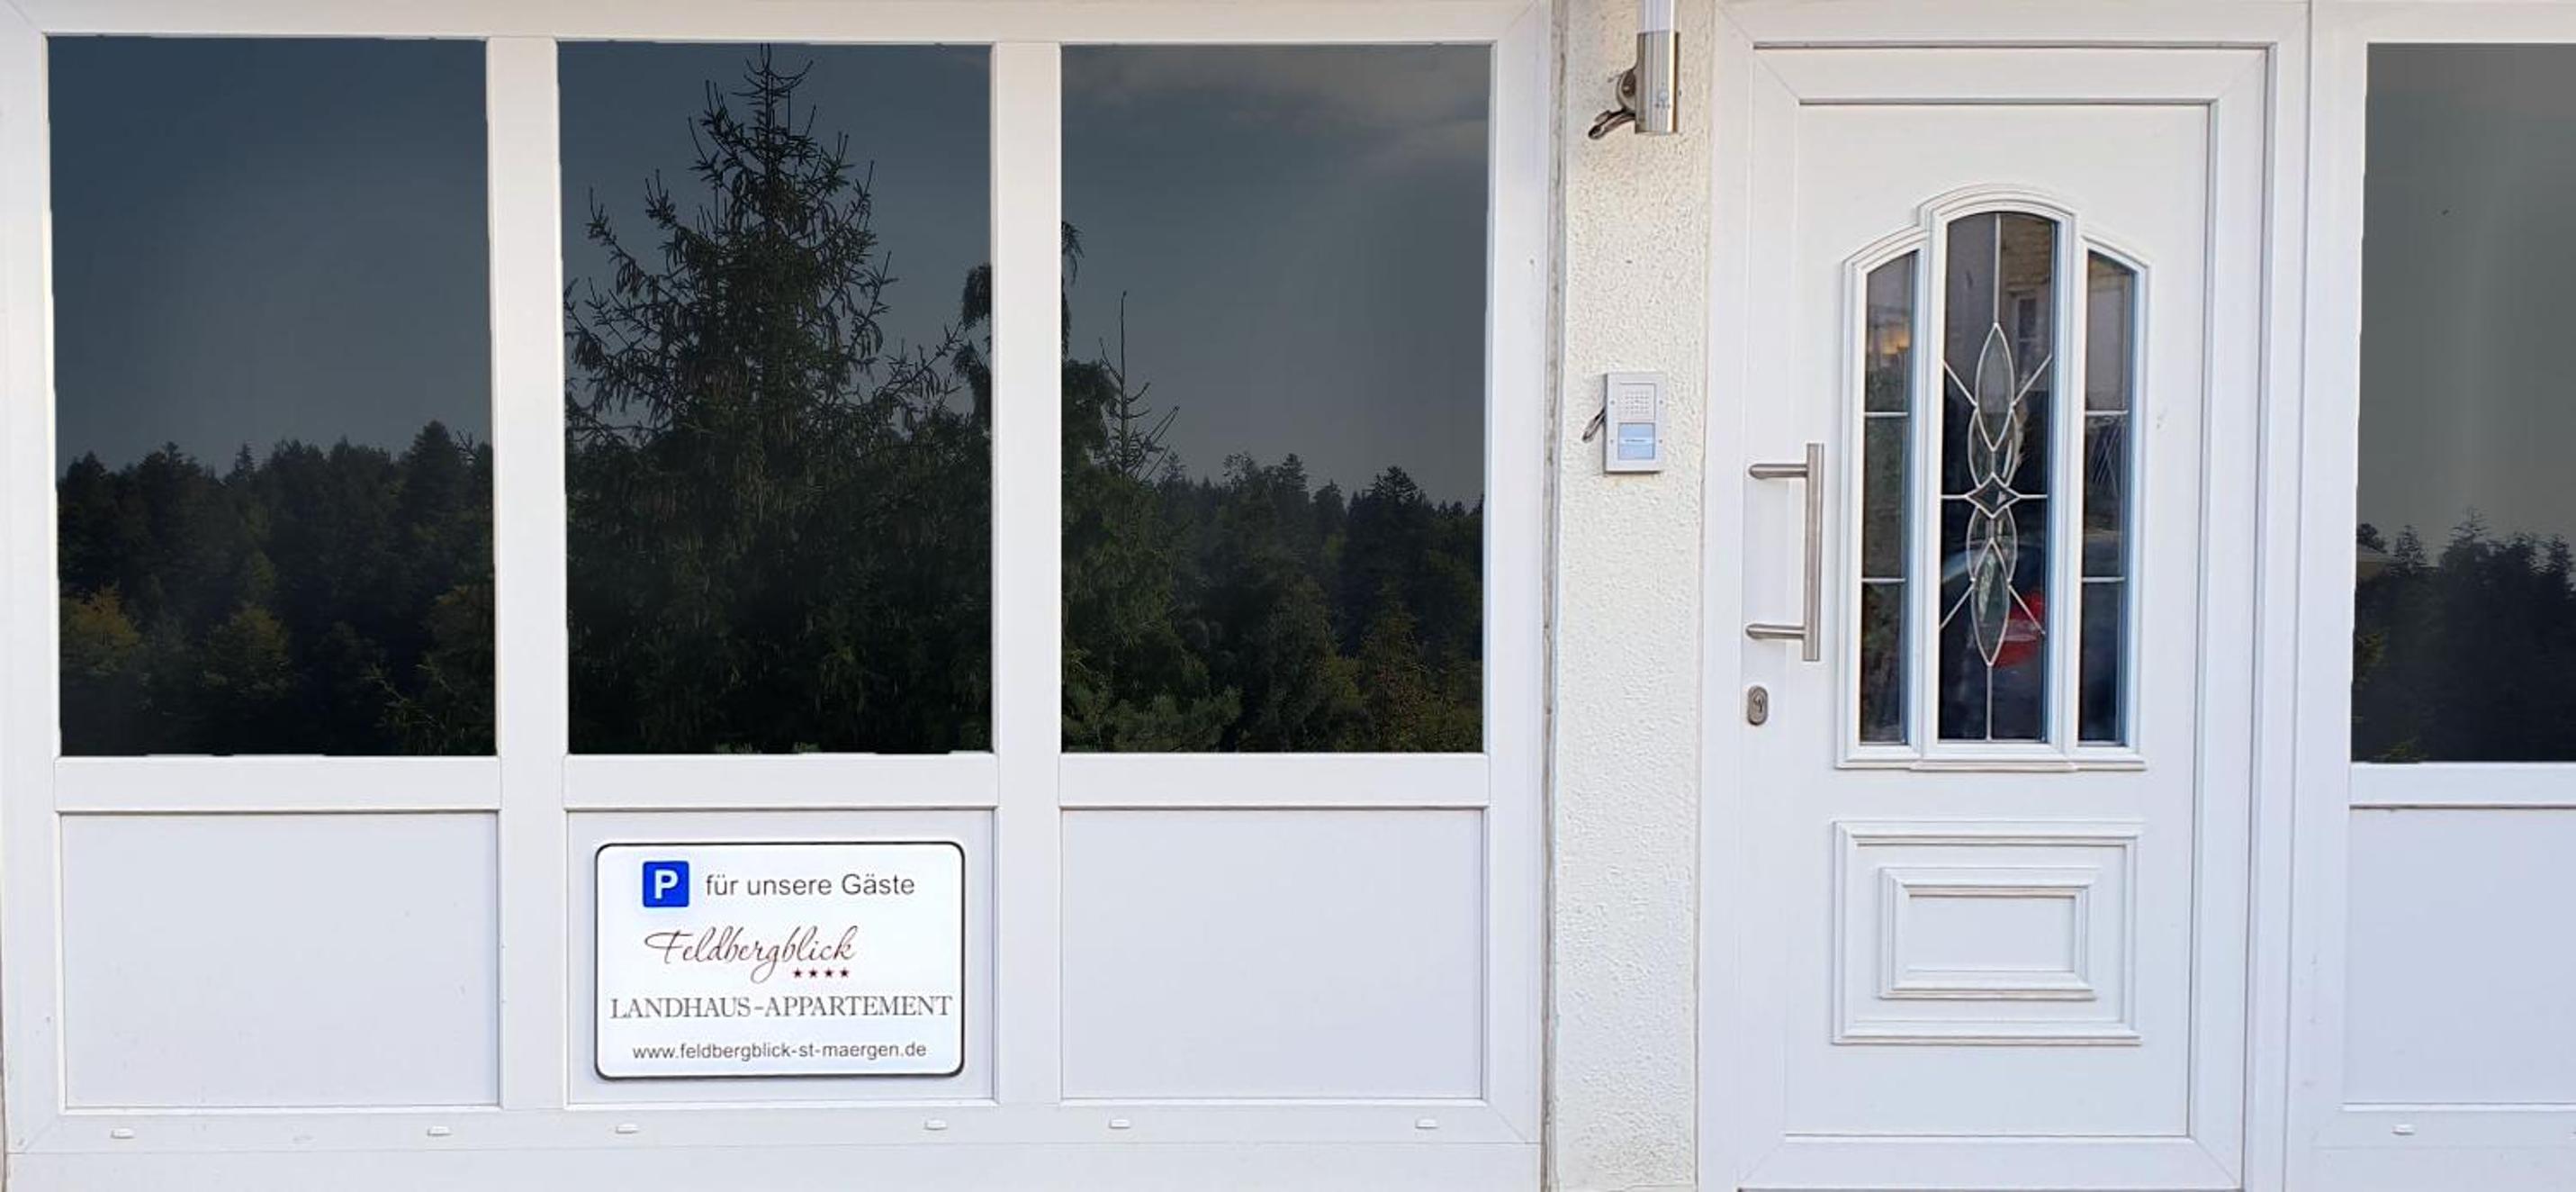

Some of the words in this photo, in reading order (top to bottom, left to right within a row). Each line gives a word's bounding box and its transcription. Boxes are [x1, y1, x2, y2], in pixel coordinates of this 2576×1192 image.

[653, 870, 678, 899] P
[706, 873, 739, 896] für
[747, 878, 832, 896] unsere
[842, 873, 915, 896] Gäste
[644, 926, 858, 983] Feldbergblick
[633, 1042, 927, 1062] www.feldbergblick-st-maergen.de
